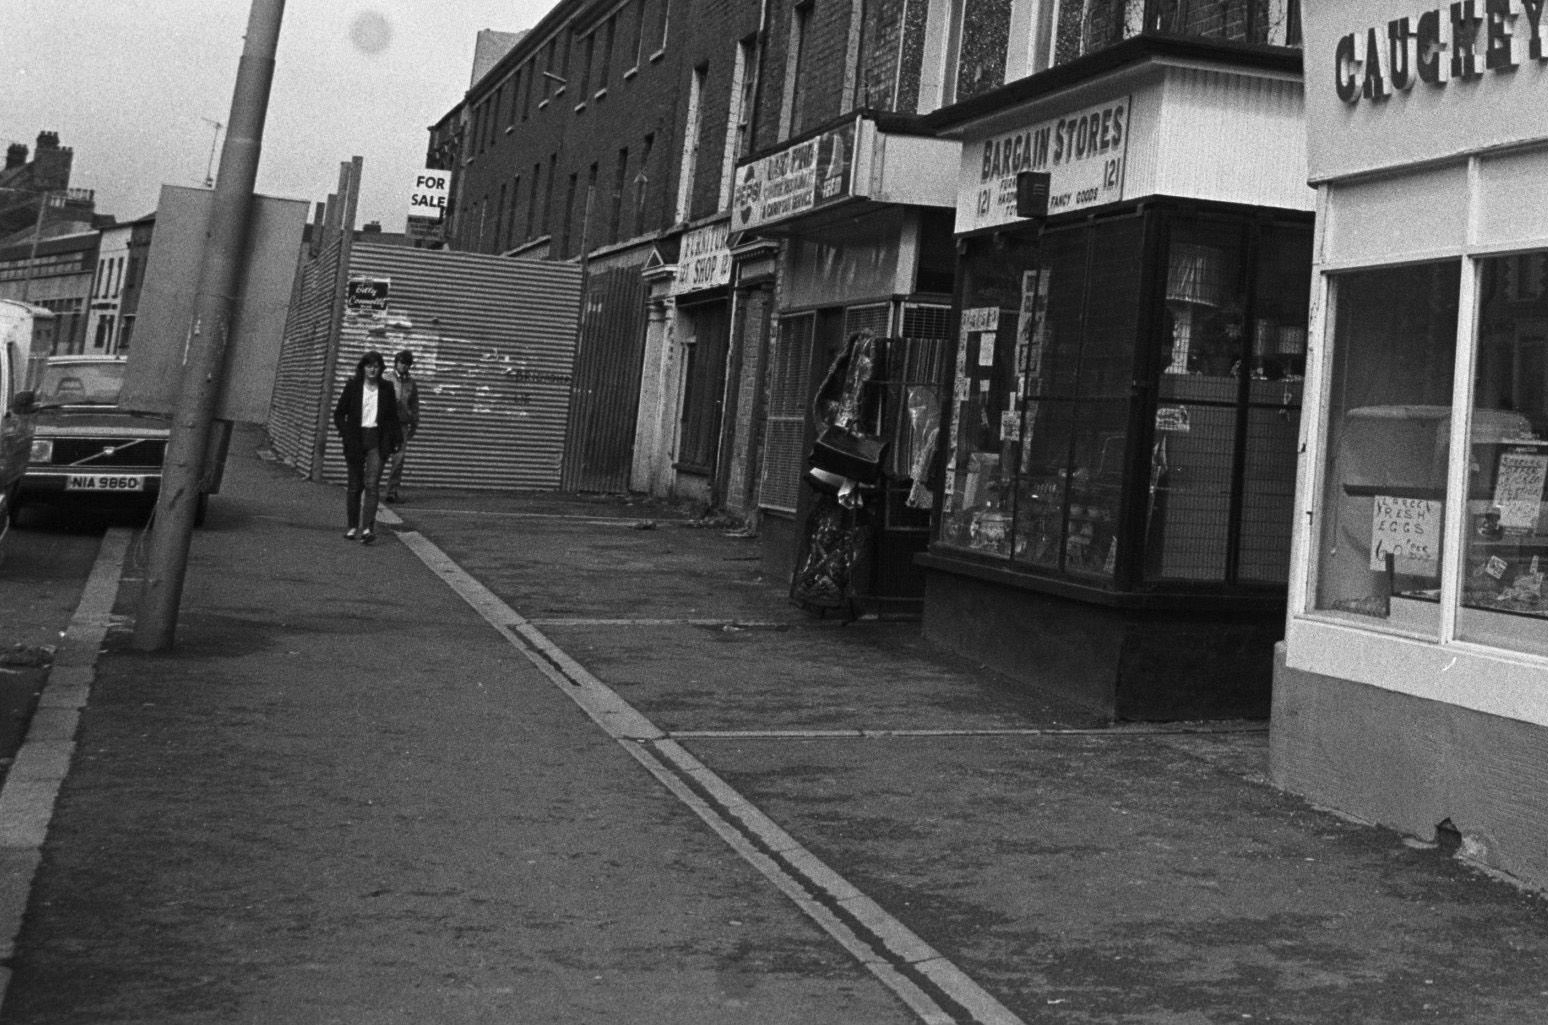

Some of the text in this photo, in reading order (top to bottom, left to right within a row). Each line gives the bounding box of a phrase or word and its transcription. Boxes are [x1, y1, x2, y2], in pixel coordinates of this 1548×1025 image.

[981, 104, 1124, 185] BARGAIN STORES
[416, 175, 446, 190] FOR
[411, 193, 446, 208] SALE
[693, 255, 717, 284] SHOP
[73, 477, 95, 488] NIA
[1379, 520, 1424, 535] EGGS
